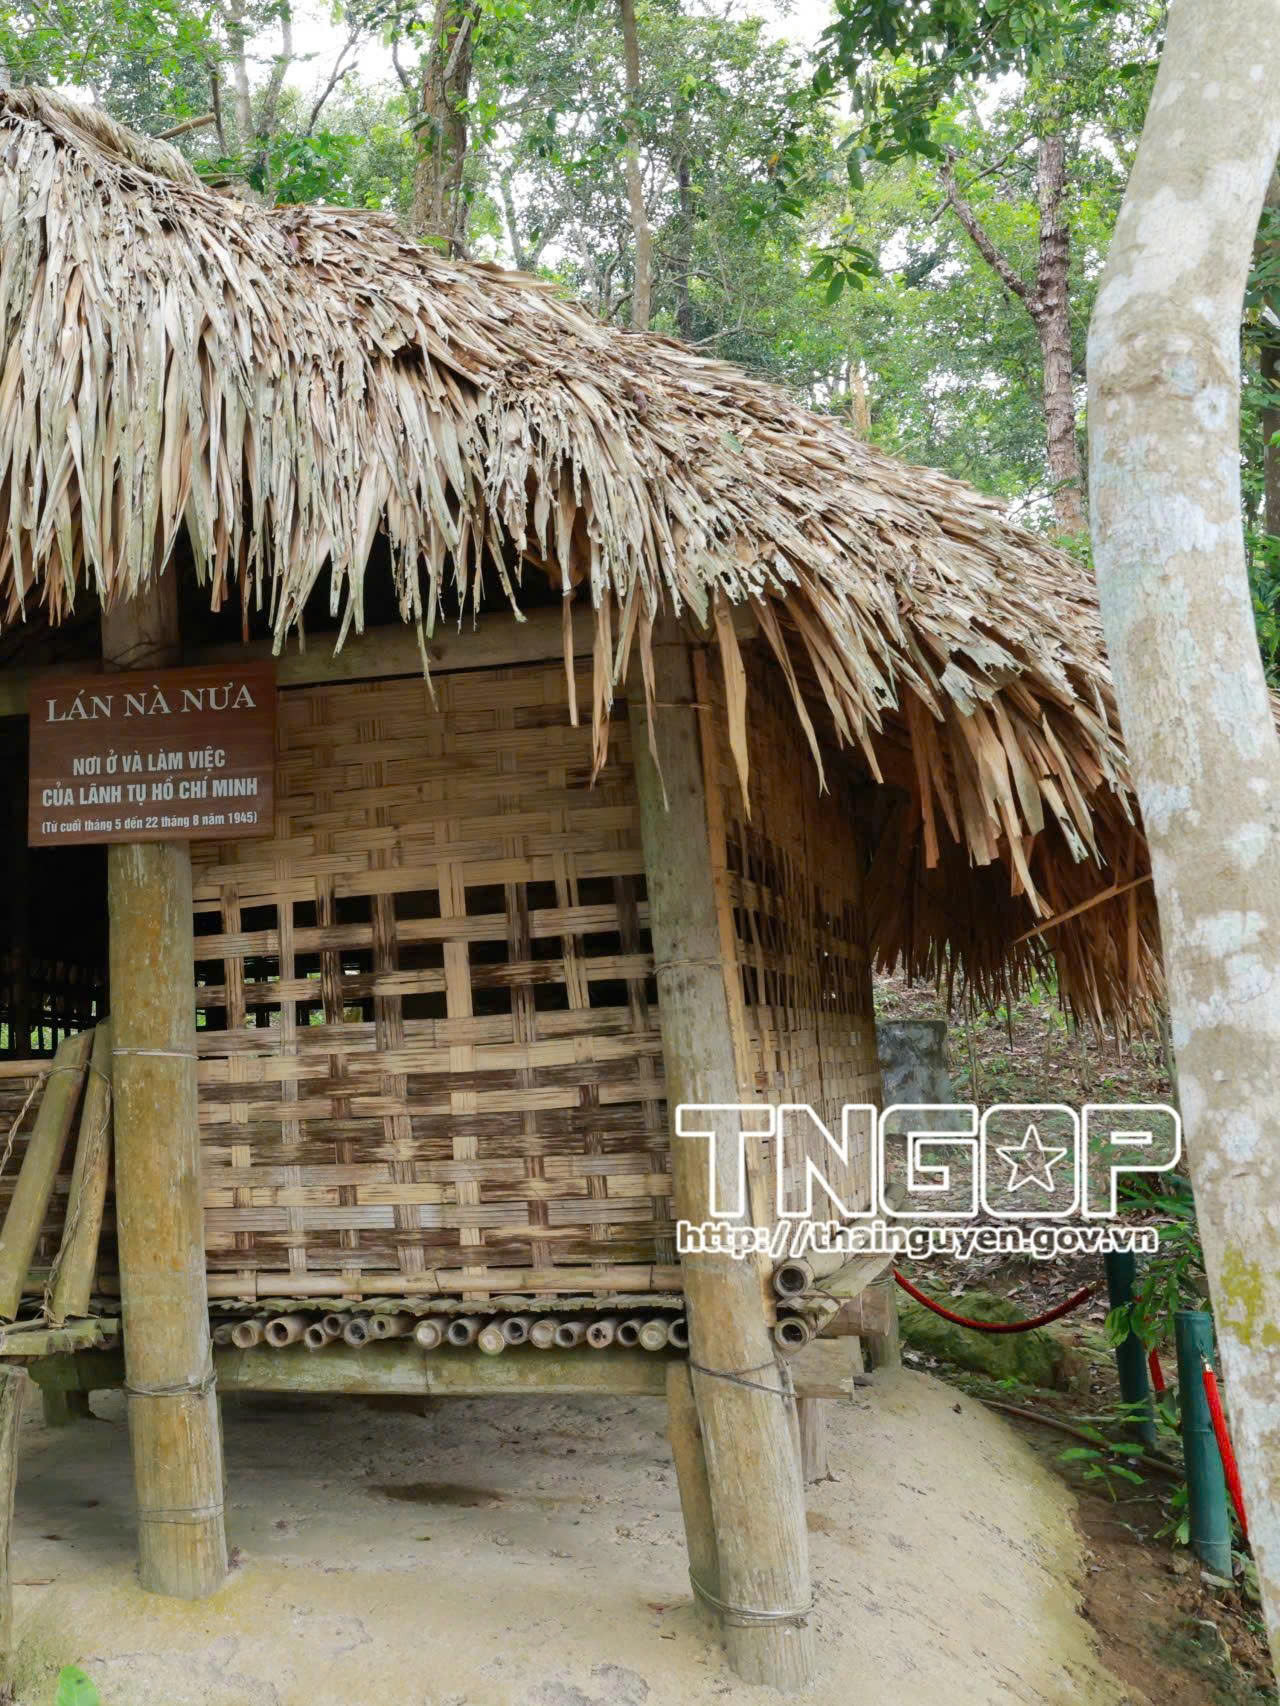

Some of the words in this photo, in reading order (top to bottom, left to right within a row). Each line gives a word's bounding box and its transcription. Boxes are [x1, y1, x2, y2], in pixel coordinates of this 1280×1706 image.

[46, 689, 114, 722] LÁN
[124, 684, 171, 717] NÀ
[73, 756, 101, 776] NƠI
[107, 749, 118, 774] Ở
[122, 752, 143, 773] VÀ
[148, 749, 183, 772] LÀM
[189, 745, 226, 772] VIỆC
[42, 781, 74, 807] CỦA
[79, 783, 121, 805] LÃNH
[127, 783, 146, 806] TỤ
[152, 775, 174, 801] HỒ
[179, 776, 208, 799] CHÍ
[212, 777, 258, 797] MINH
[115, 818, 122, 830] 5
[145, 816, 159, 829] 22
[192, 814, 199, 826] 8
[228, 810, 258, 825] 1945)
